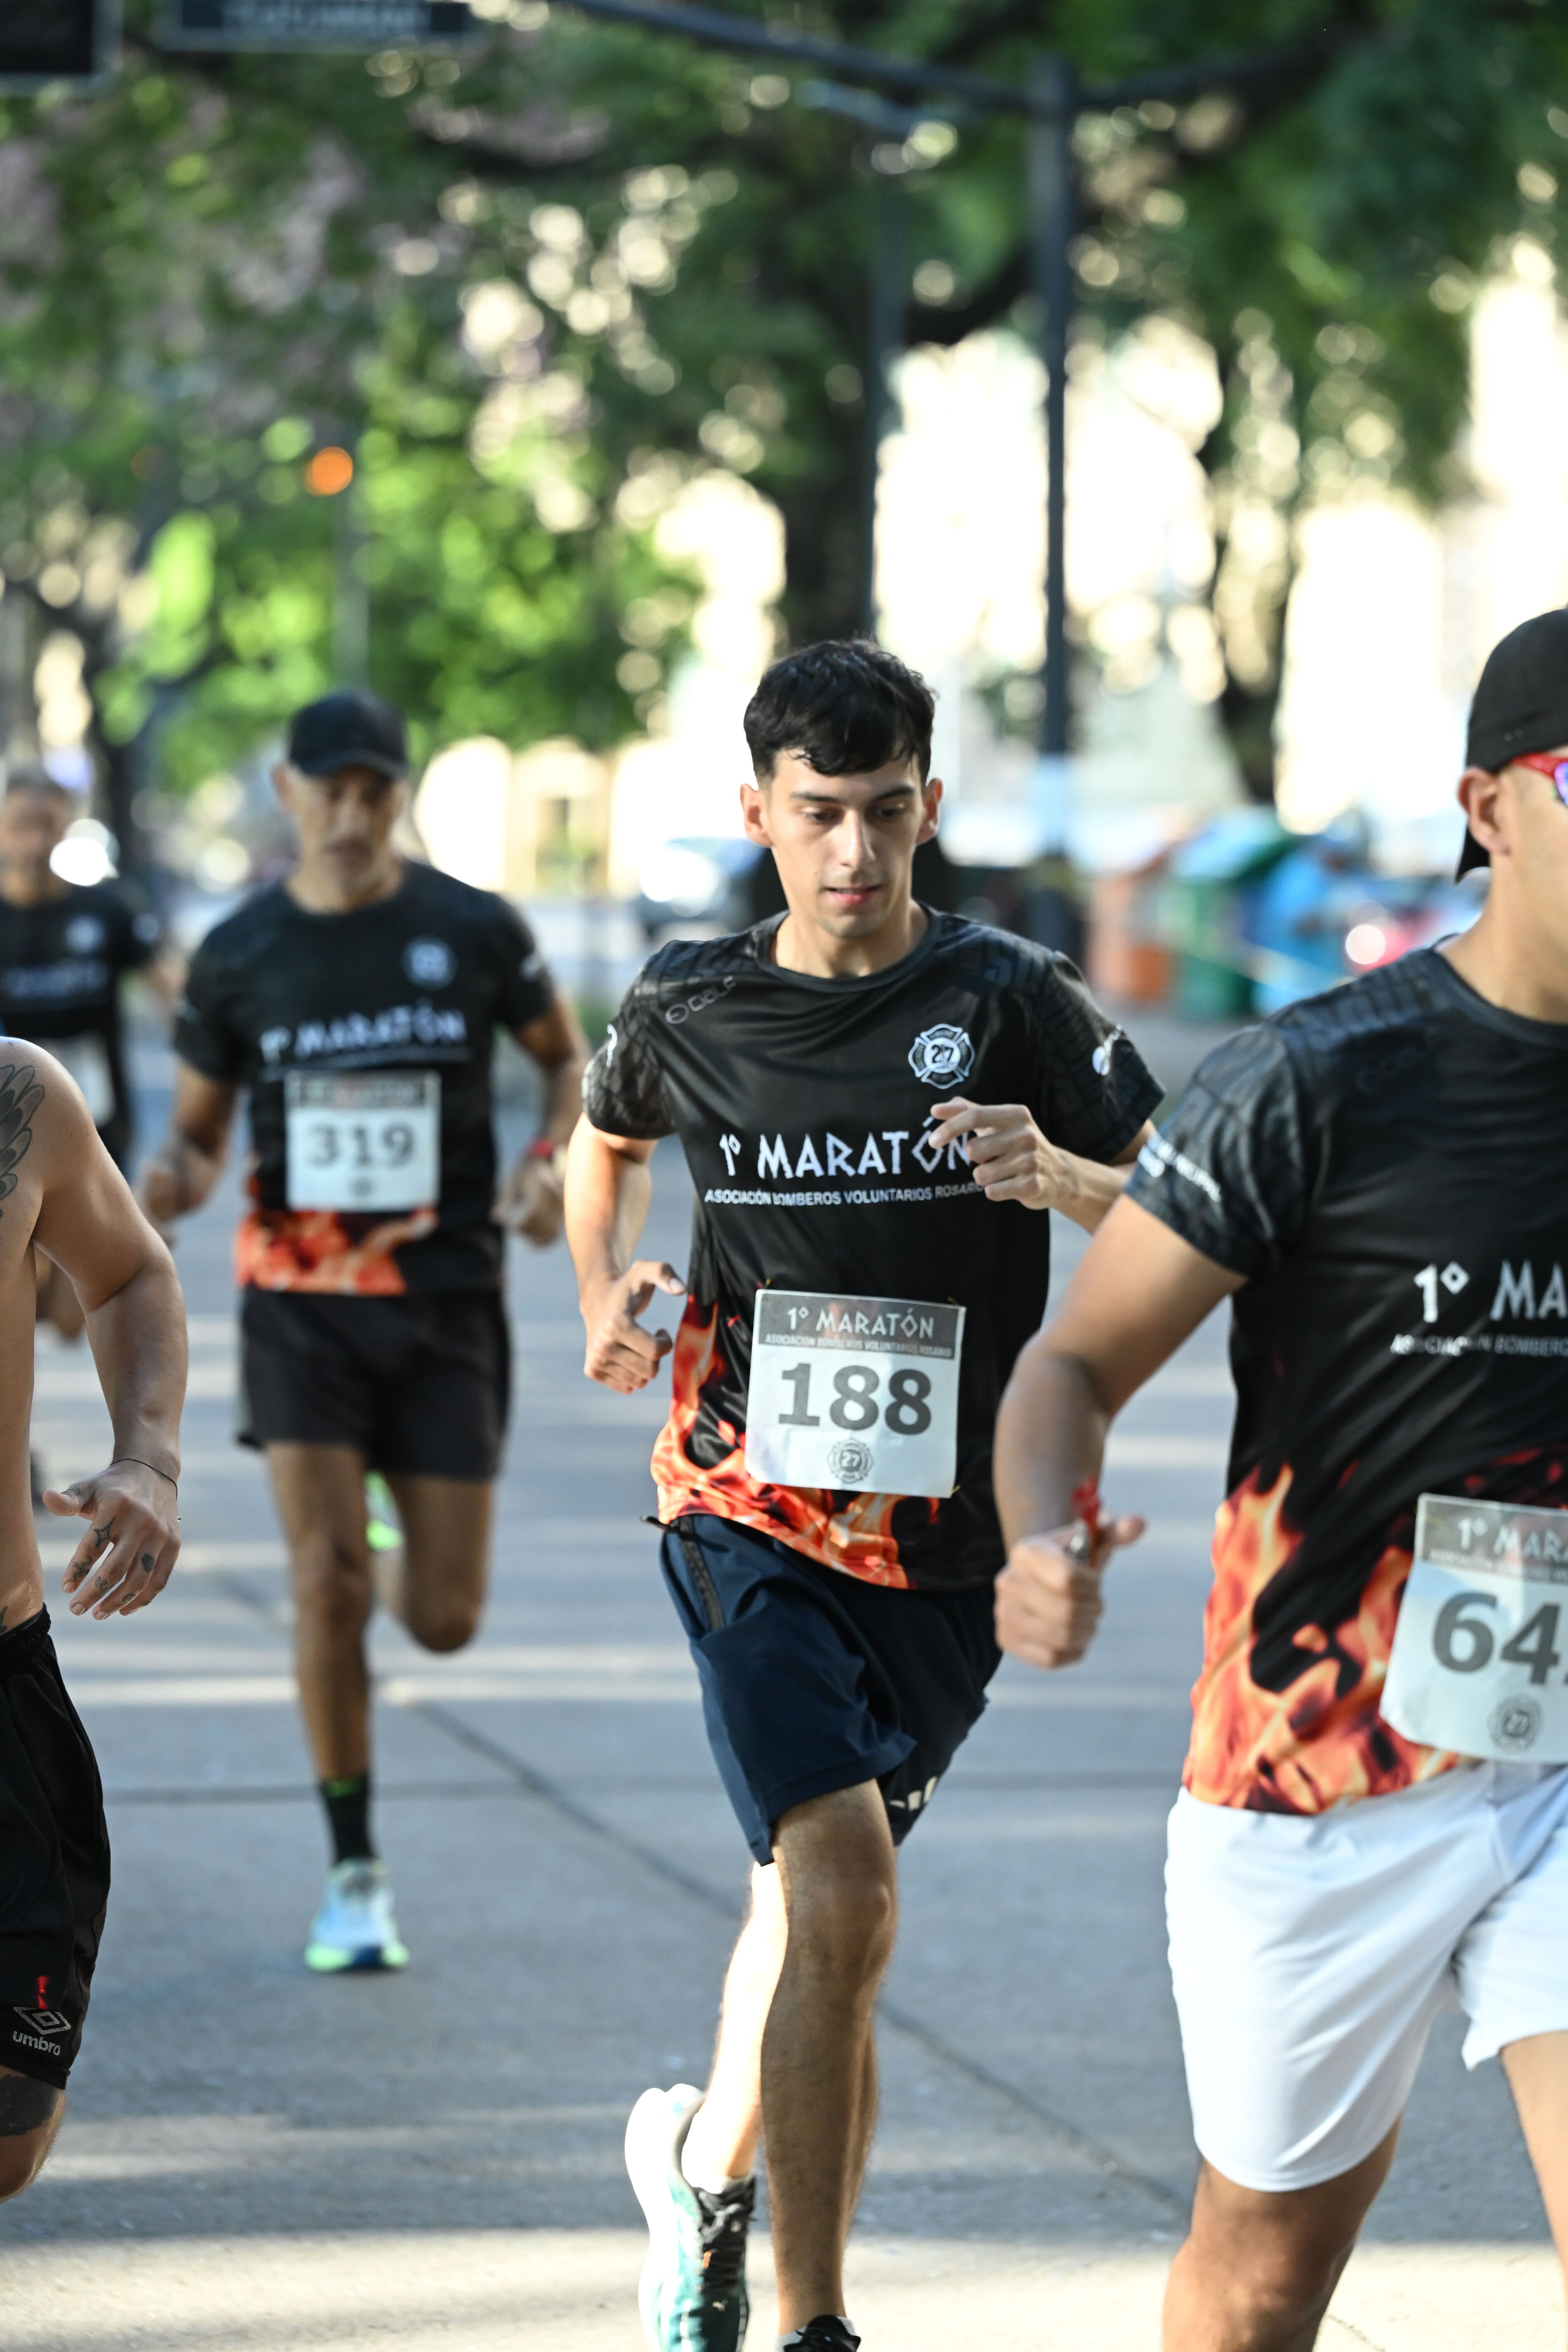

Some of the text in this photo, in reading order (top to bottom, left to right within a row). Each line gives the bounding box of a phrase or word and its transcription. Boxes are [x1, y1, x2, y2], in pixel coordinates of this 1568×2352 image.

[931, 1044, 954, 1064] 27
[308, 1122, 415, 1169] 319
[843, 1186, 933, 1204] VOLUNTARIOS
[815, 1307, 935, 1340] MARATÓN
[777, 1362, 932, 1436] 188
[841, 1451, 861, 1467] 27
[1431, 1591, 1568, 1686] 64
[12, 2030, 61, 2056] umbro
